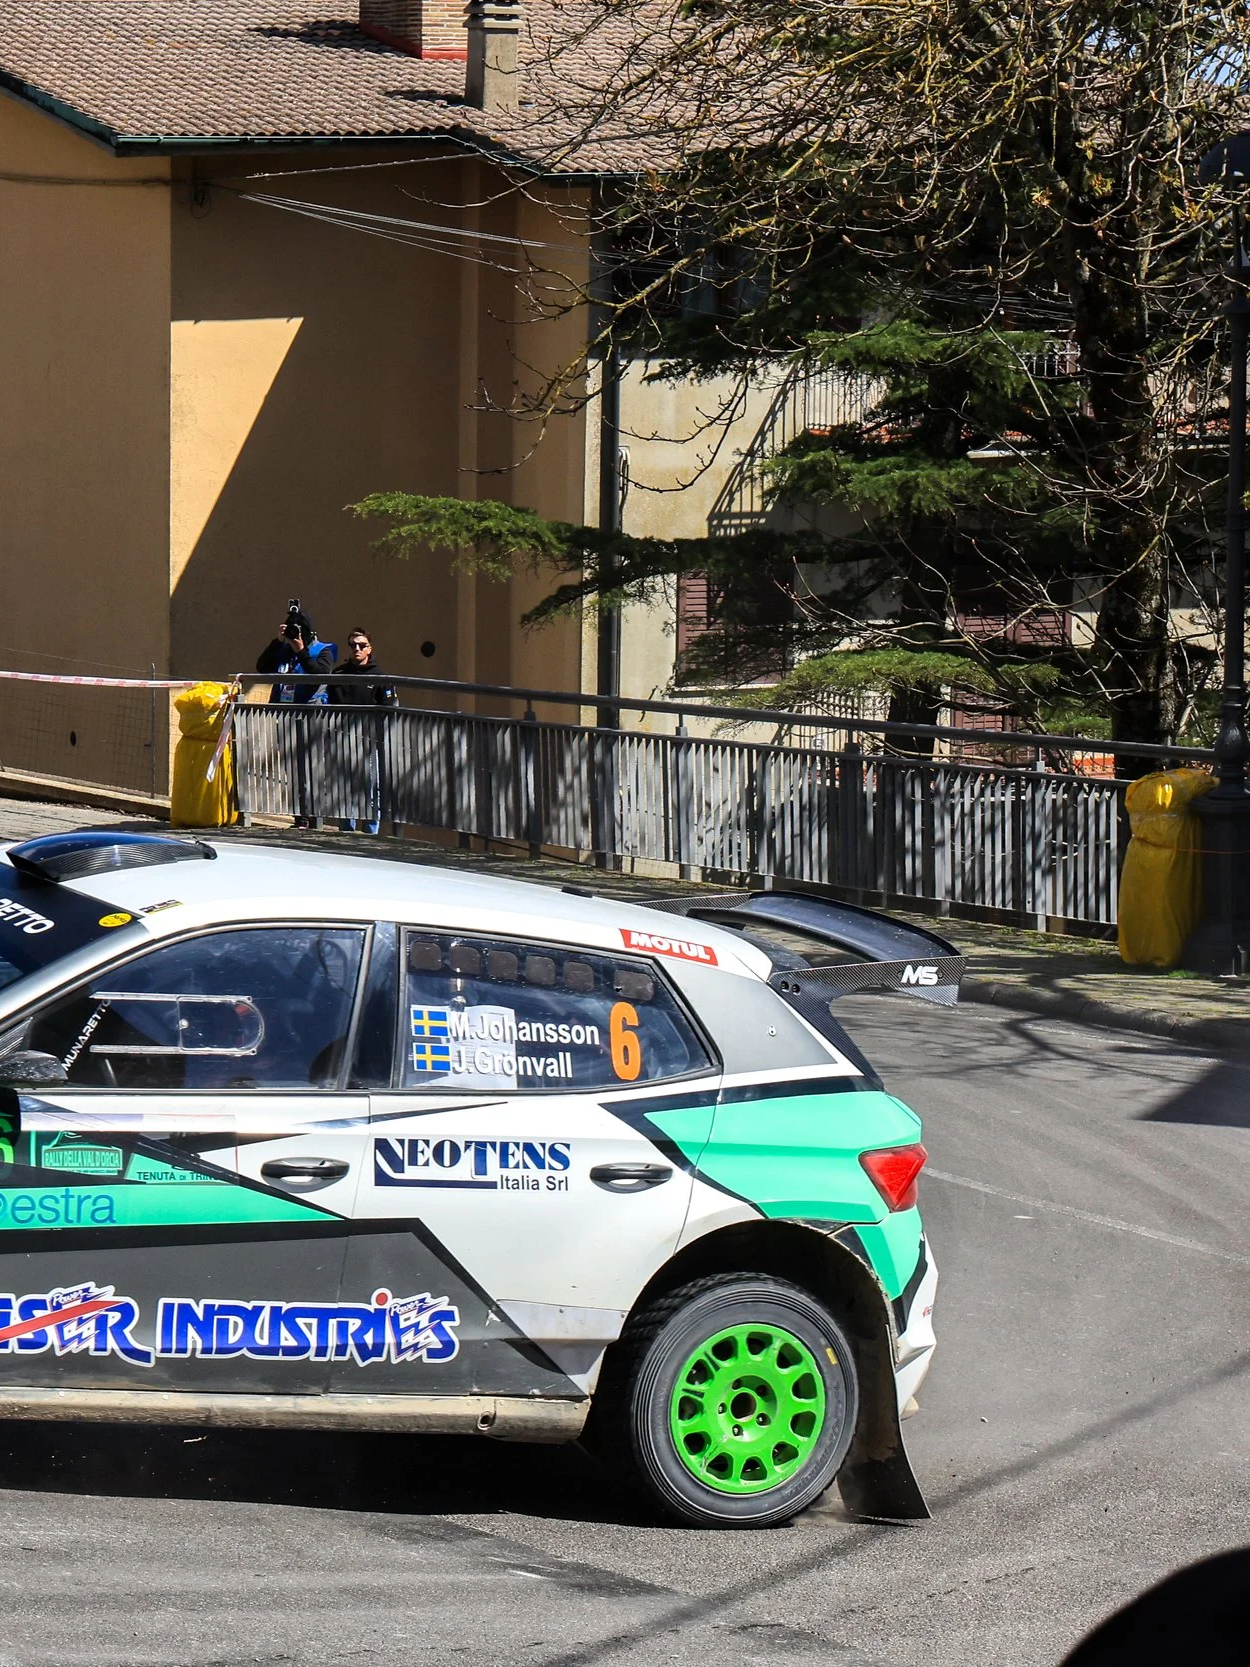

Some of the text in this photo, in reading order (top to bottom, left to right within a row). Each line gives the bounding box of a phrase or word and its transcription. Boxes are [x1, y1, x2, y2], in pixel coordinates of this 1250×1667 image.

[630, 932, 710, 960] MOTUL
[900, 964, 939, 986] MS
[61, 999, 111, 1071] MUNARETTO
[610, 1001, 642, 1081] 6
[374, 1137, 571, 1176] NEOTENS
[137, 1171, 176, 1181] TENUTA
[500, 1174, 569, 1191] Italia Srl
[11, 1188, 117, 1224] estra
[52, 1288, 85, 1307] Power
[390, 1300, 422, 1316] Power
